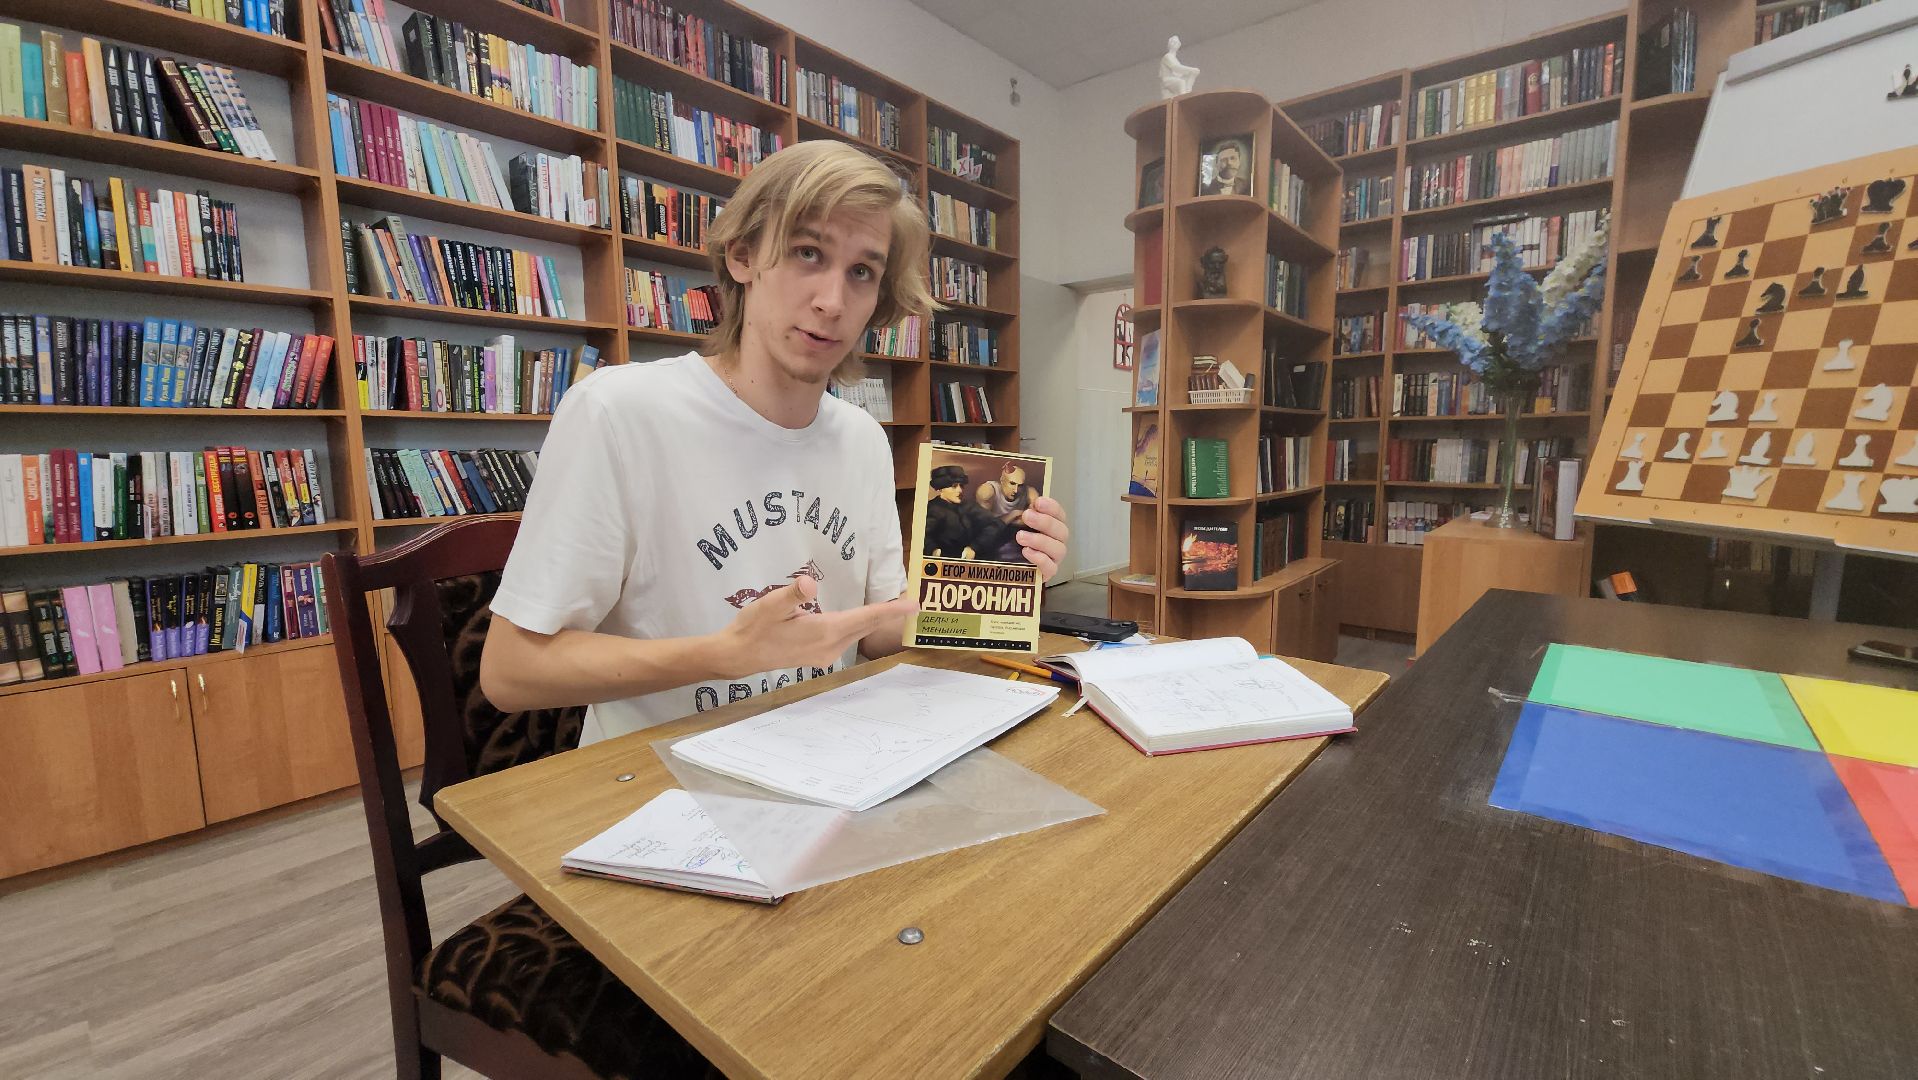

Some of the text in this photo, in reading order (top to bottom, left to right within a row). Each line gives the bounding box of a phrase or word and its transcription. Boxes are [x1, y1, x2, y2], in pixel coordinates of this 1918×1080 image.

[696, 489, 856, 571] MUSTANG
[942, 565, 1035, 583] ЕГОР МИХАЙЛОВИЧ
[922, 582, 1031, 613] ДОРОНИН
[921, 626, 967, 635] МЕНЬШИЕ
